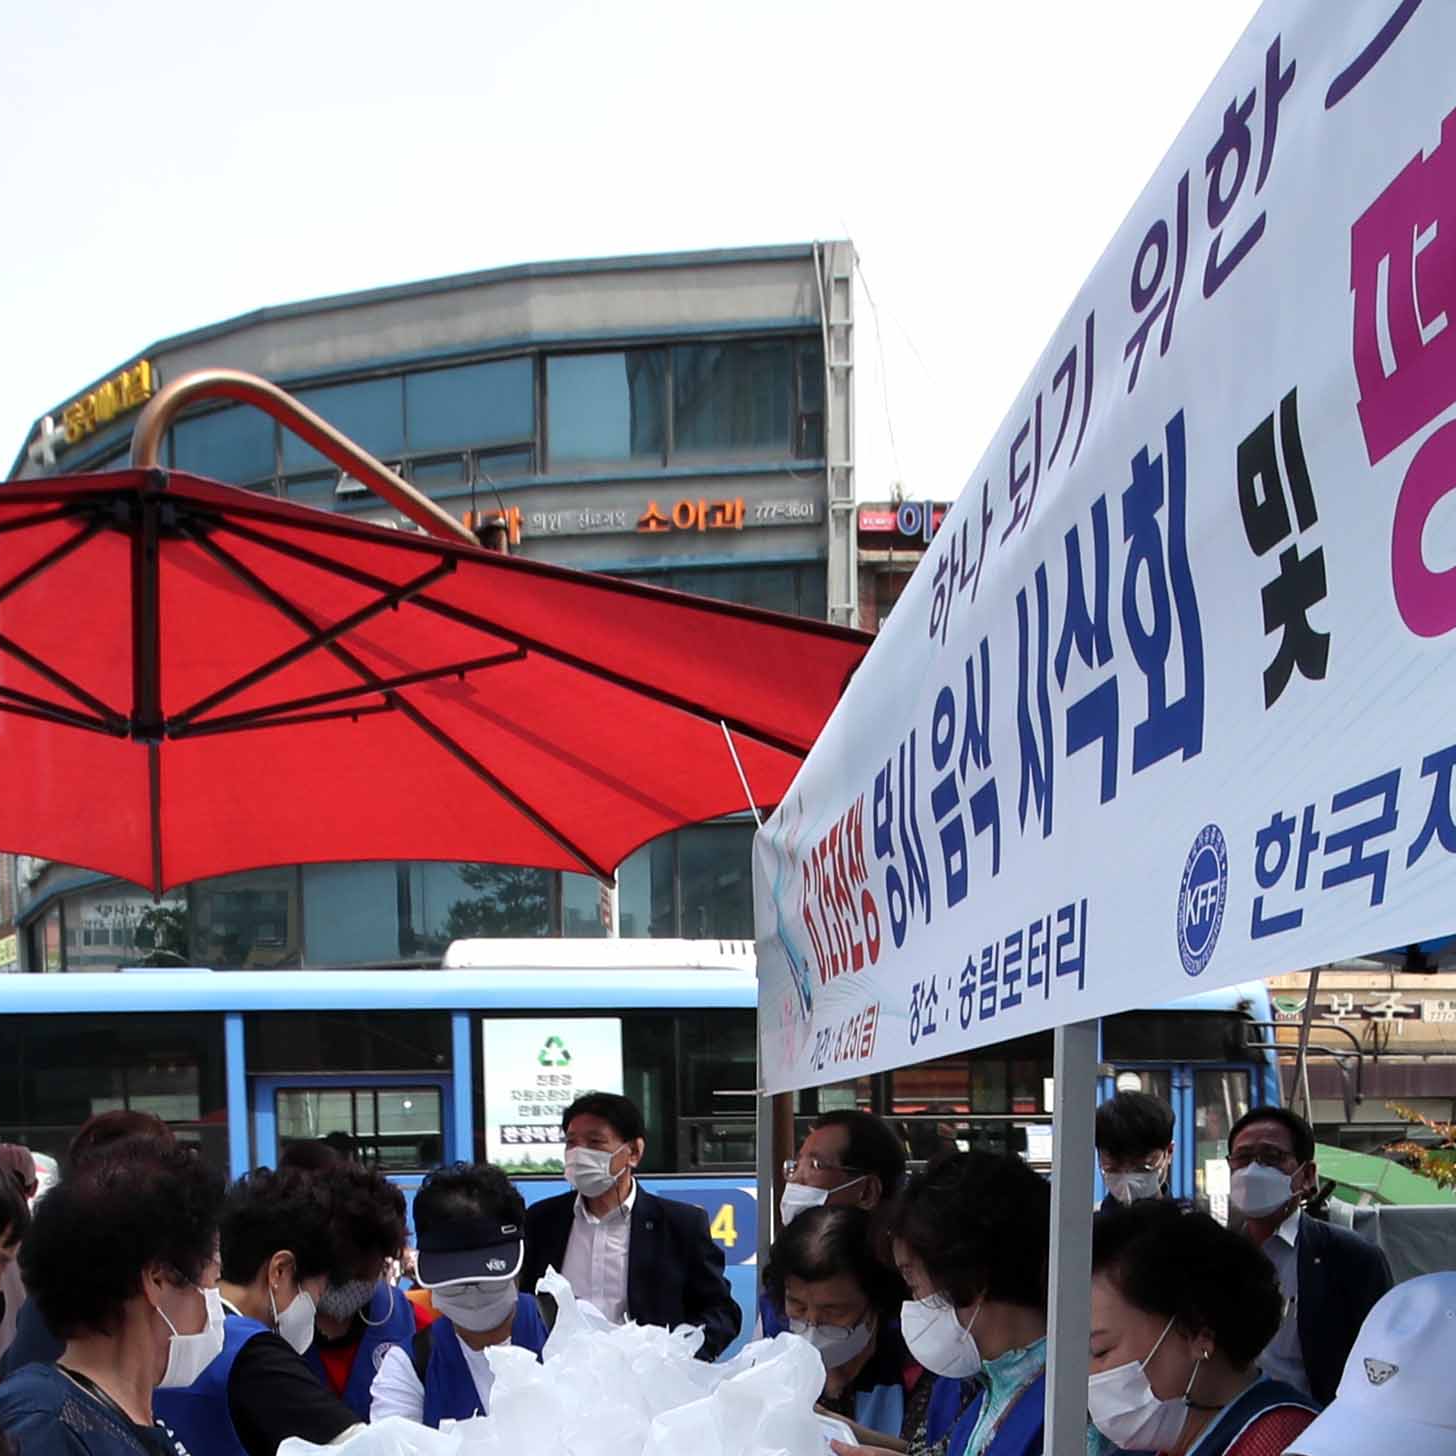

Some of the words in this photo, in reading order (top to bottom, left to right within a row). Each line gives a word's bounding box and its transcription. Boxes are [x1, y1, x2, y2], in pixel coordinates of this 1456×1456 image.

[636, 497, 744, 533] 소아과
[754, 502, 815, 521] 777-3601
[929, 480, 994, 647] 하나
[999, 309, 1096, 548] 되기
[1122, 30, 1298, 395] 위한
[873, 728, 932, 950] 당시
[930, 636, 1002, 910] 음식
[1016, 407, 1206, 839] 시식회
[1236, 385, 1332, 712] 및
[908, 968, 939, 1047] 장소
[958, 898, 1090, 1025] 송림로터리
[1185, 878, 1220, 929] KFF
